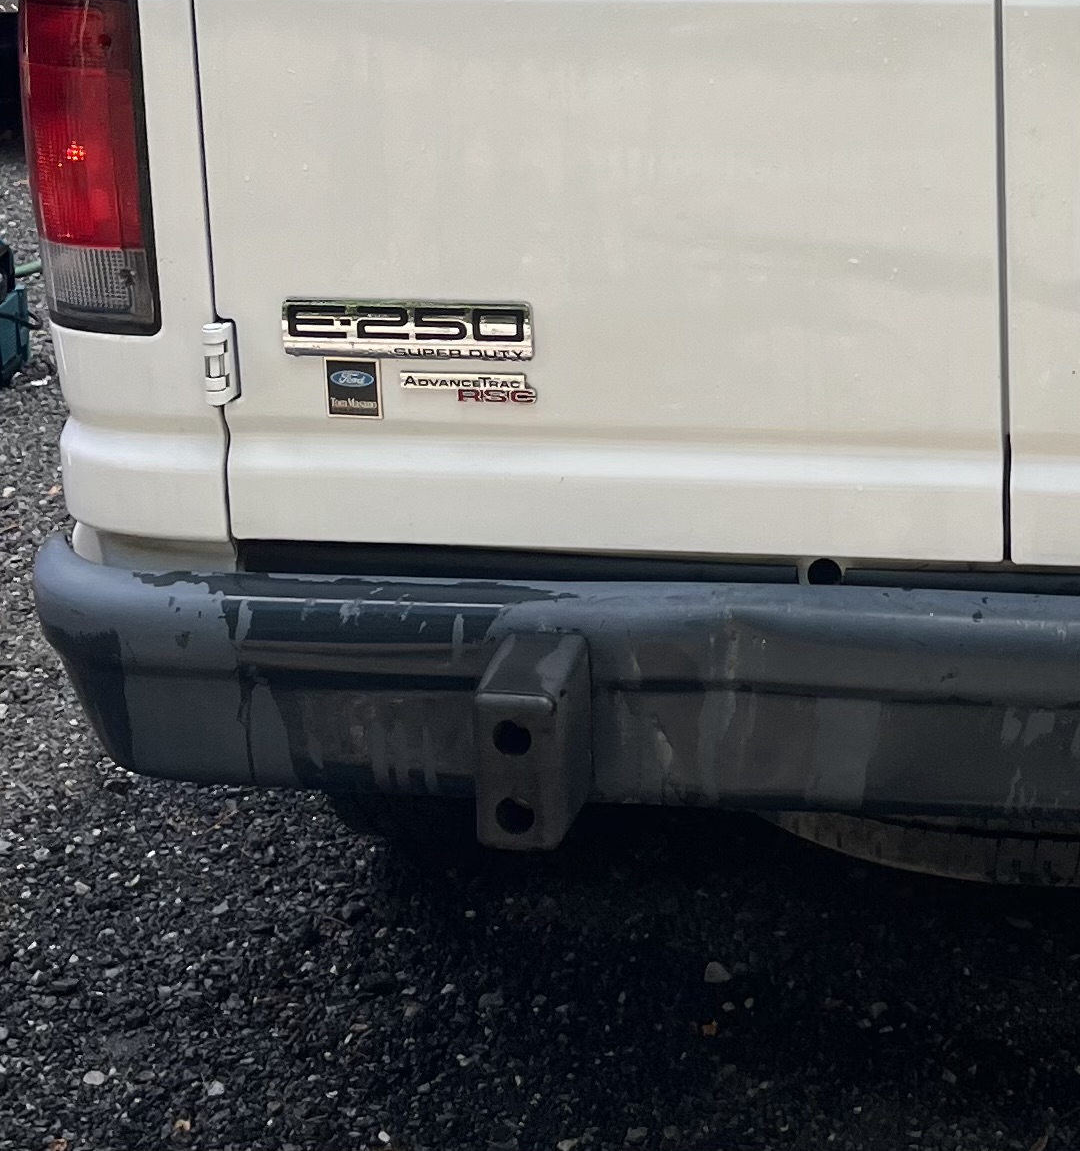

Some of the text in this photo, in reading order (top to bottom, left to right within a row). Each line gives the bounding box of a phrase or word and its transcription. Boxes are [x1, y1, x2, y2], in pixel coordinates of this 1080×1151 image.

[286, 304, 525, 342] E-250
[393, 347, 525, 361] SUPER DUTY
[457, 389, 537, 403] RSC
